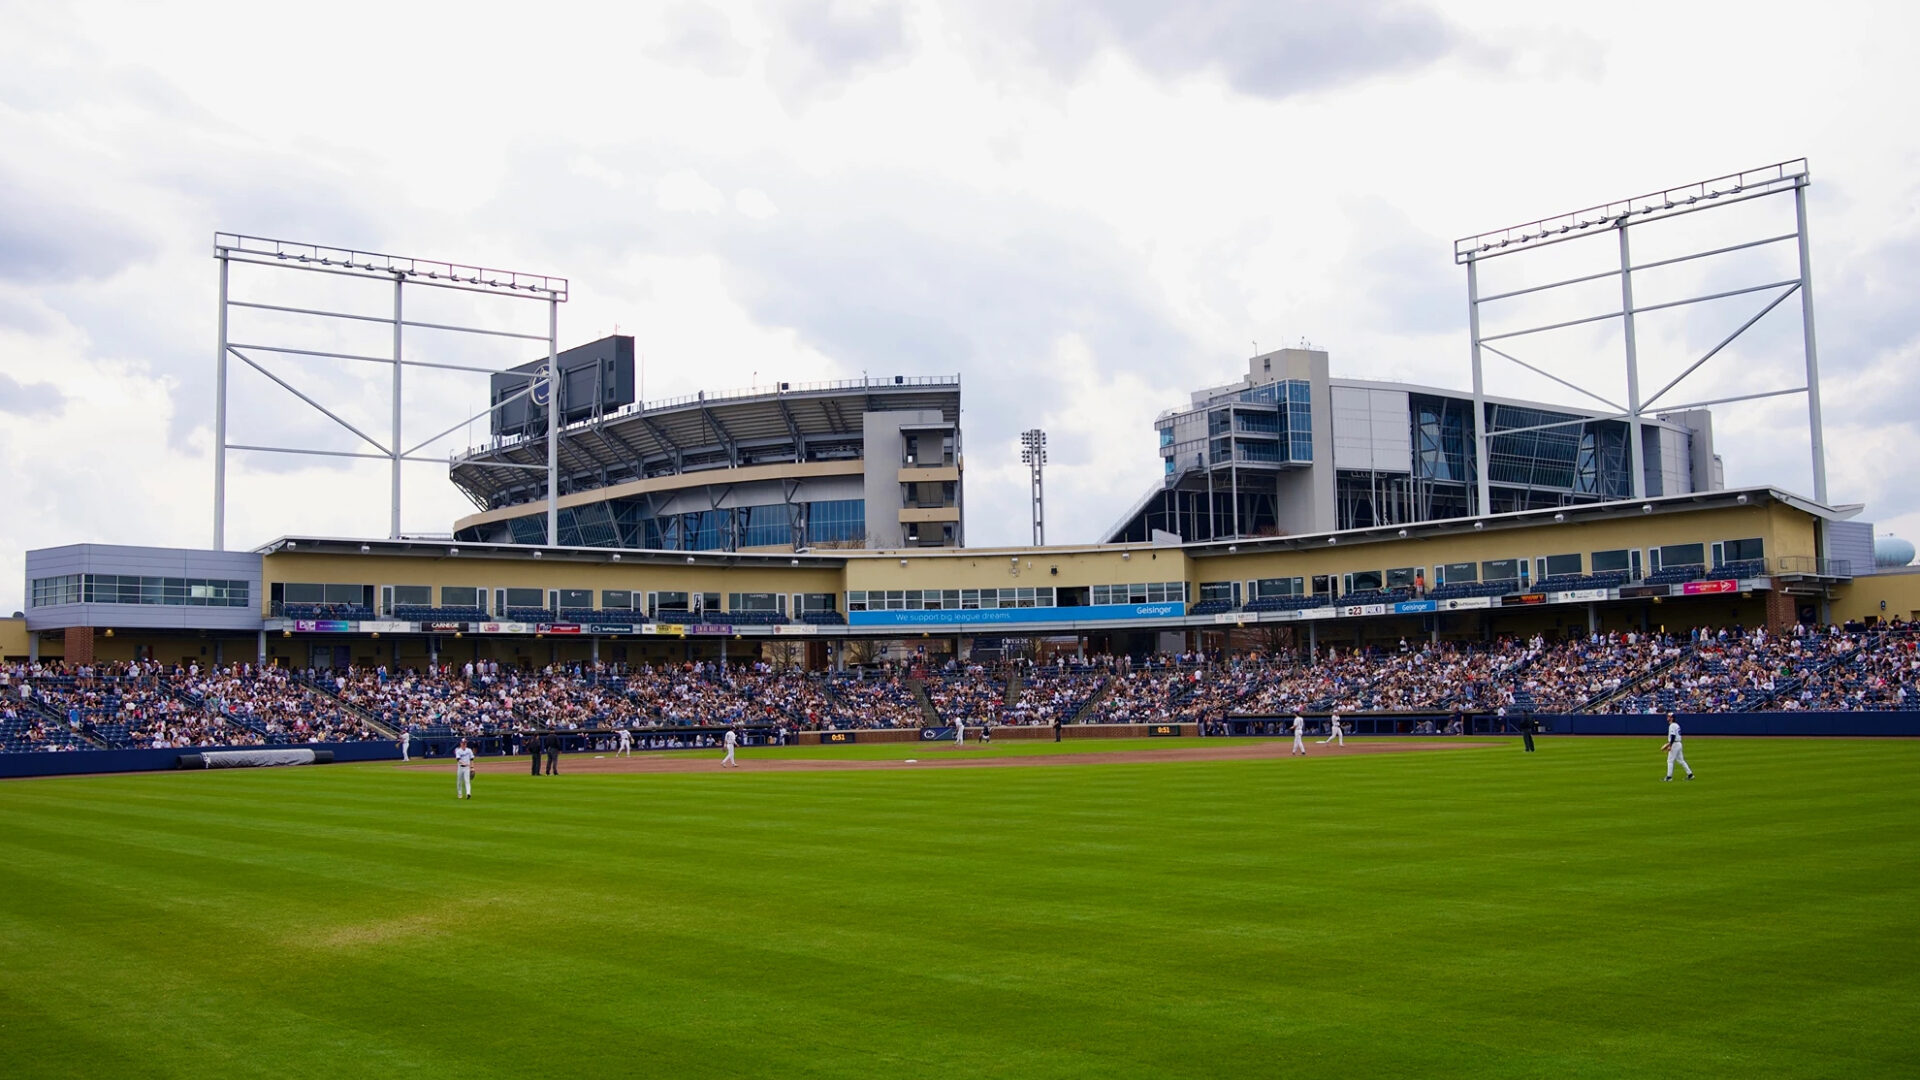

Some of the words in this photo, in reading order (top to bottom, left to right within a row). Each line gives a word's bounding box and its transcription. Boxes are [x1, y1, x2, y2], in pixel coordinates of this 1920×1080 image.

[1136, 606, 1172, 615] Geisinger
[1402, 604, 1427, 612] Geisinger
[896, 613, 908, 621] We
[910, 614, 938, 622] support
[941, 613, 952, 622] big
[954, 613, 980, 621] league
